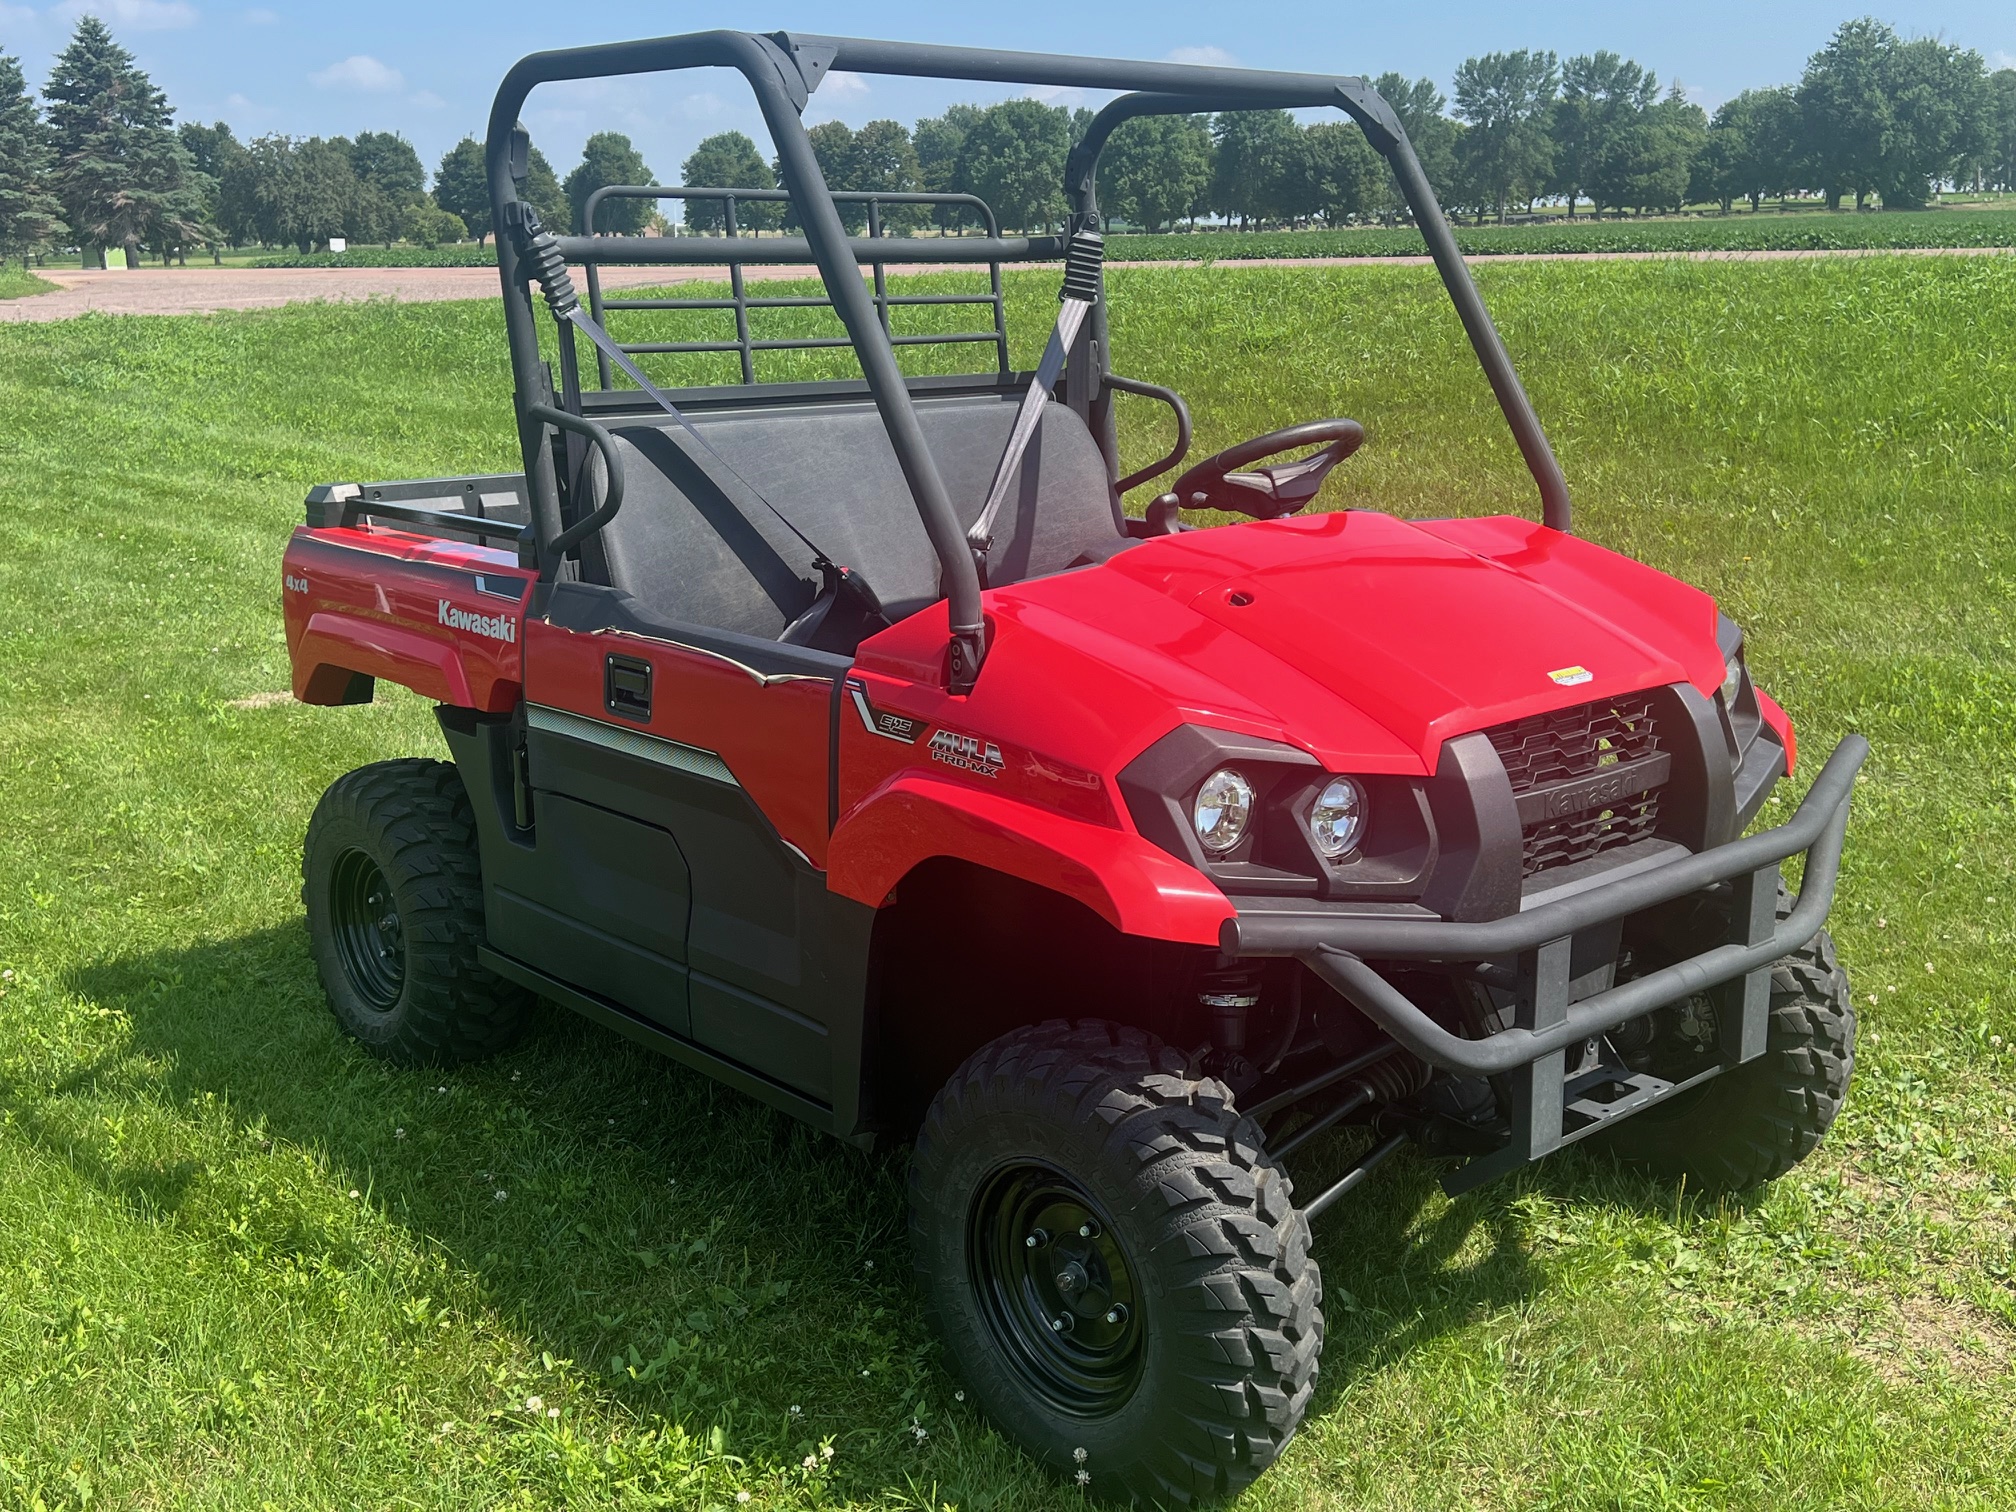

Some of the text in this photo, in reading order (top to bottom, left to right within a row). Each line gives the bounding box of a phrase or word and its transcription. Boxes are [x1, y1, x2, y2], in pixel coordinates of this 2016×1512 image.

[285, 575, 309, 594] 4x4
[438, 599, 516, 643] Kawasaki
[880, 714, 912, 731] EPS
[927, 729, 1006, 769] MULE
[1543, 768, 1638, 820] Kawasaki
